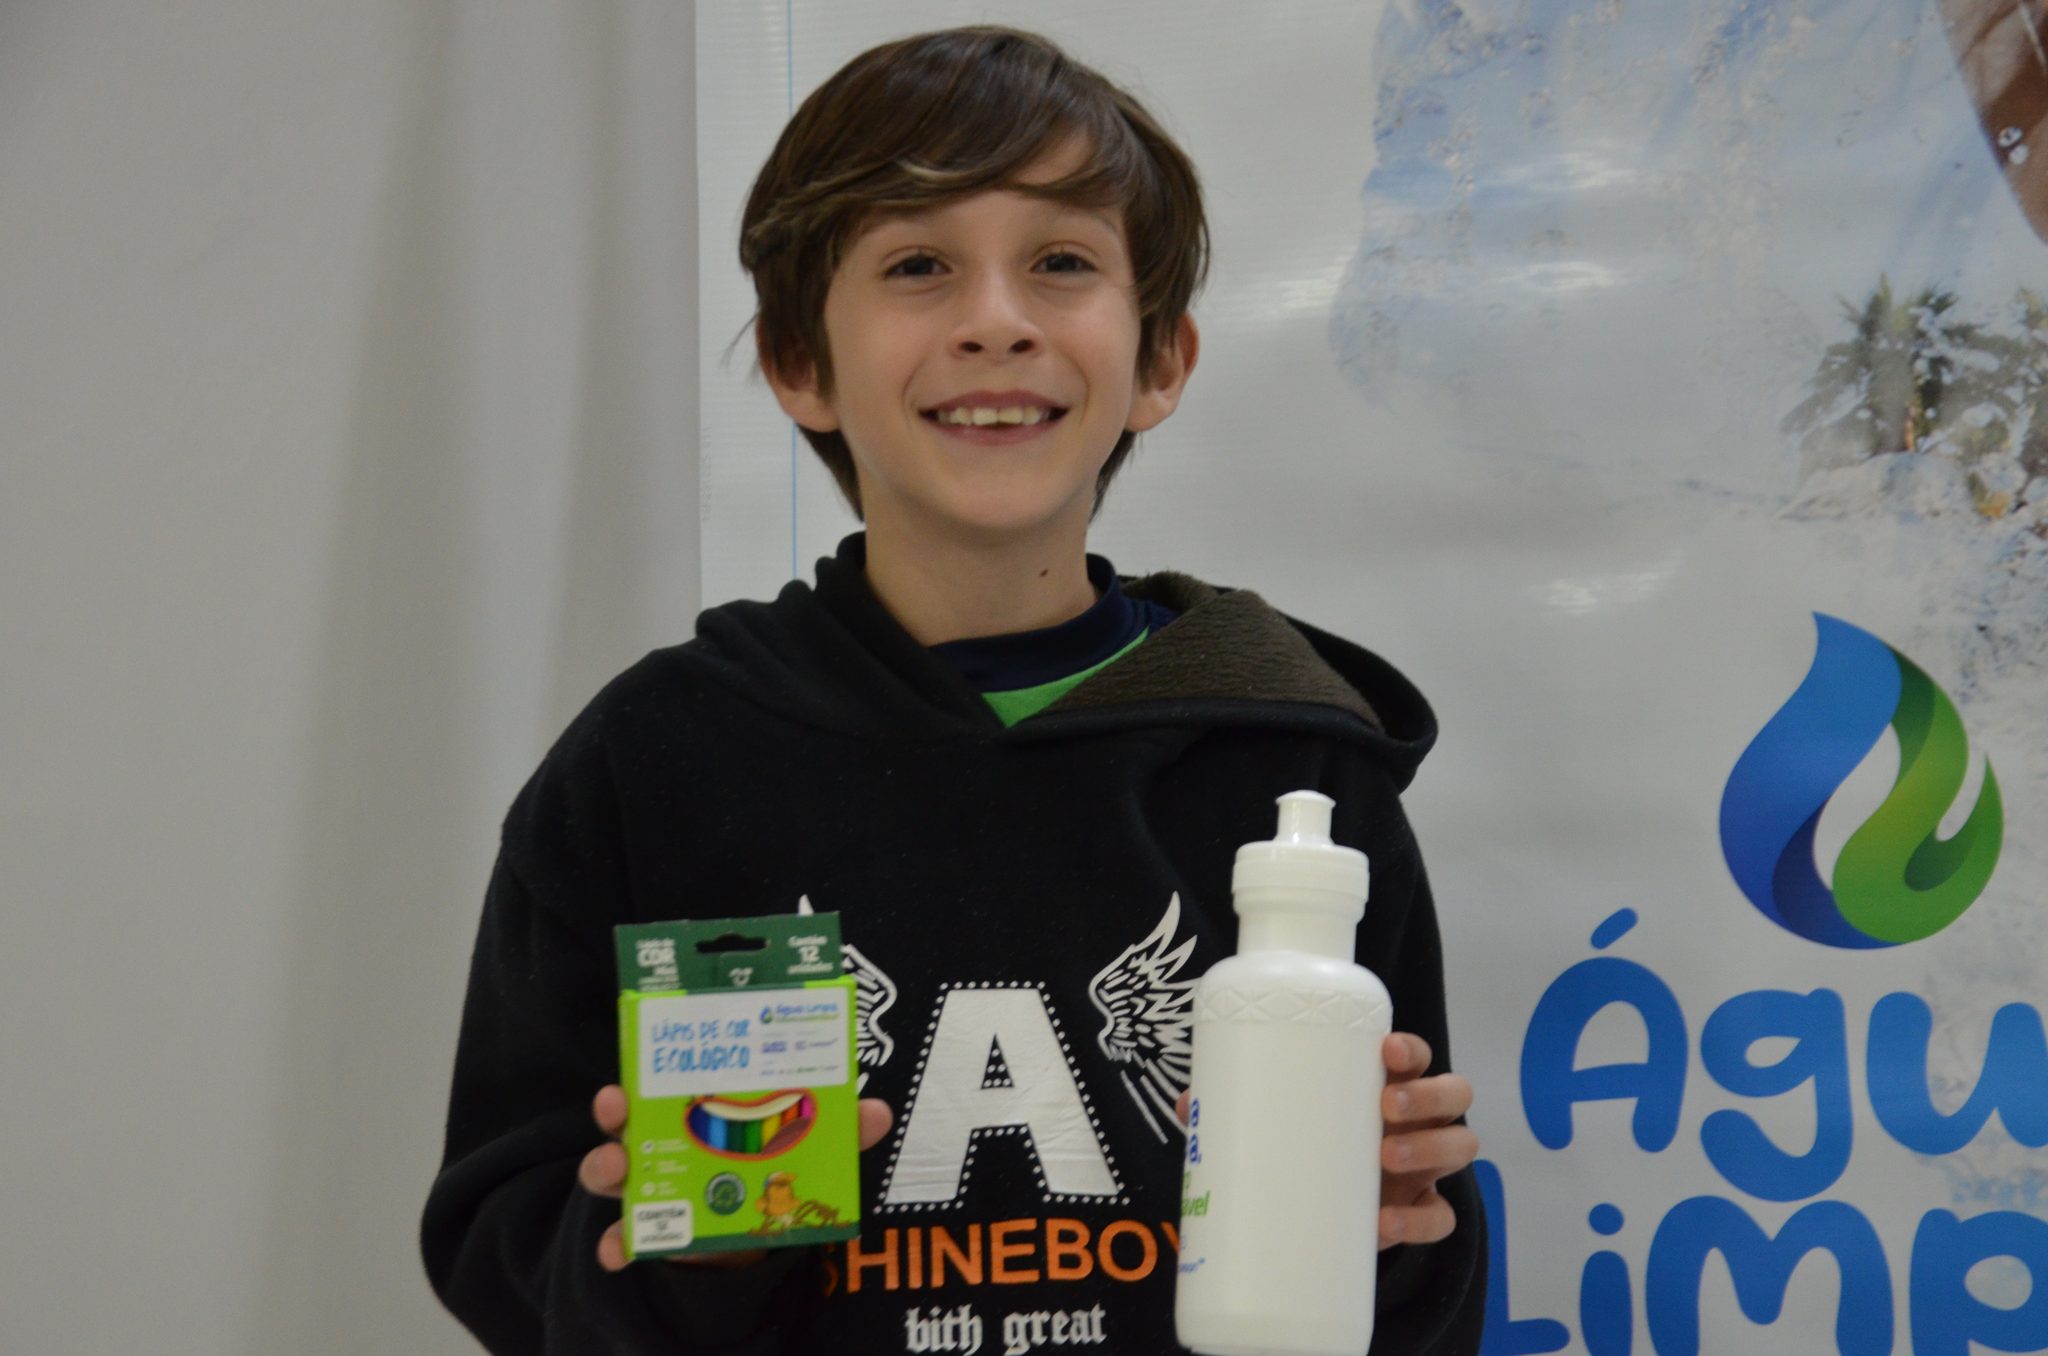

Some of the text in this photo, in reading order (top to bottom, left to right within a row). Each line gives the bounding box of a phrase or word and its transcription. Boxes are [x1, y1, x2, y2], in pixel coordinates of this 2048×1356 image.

[799, 946, 820, 962] 12
[700, 1019, 721, 1039] DE
[653, 1042, 751, 1073] ECOLÓGICO
[878, 984, 1124, 1208] A
[824, 1218, 1180, 1296] HINEBO
[1003, 1303, 1107, 1356] great
